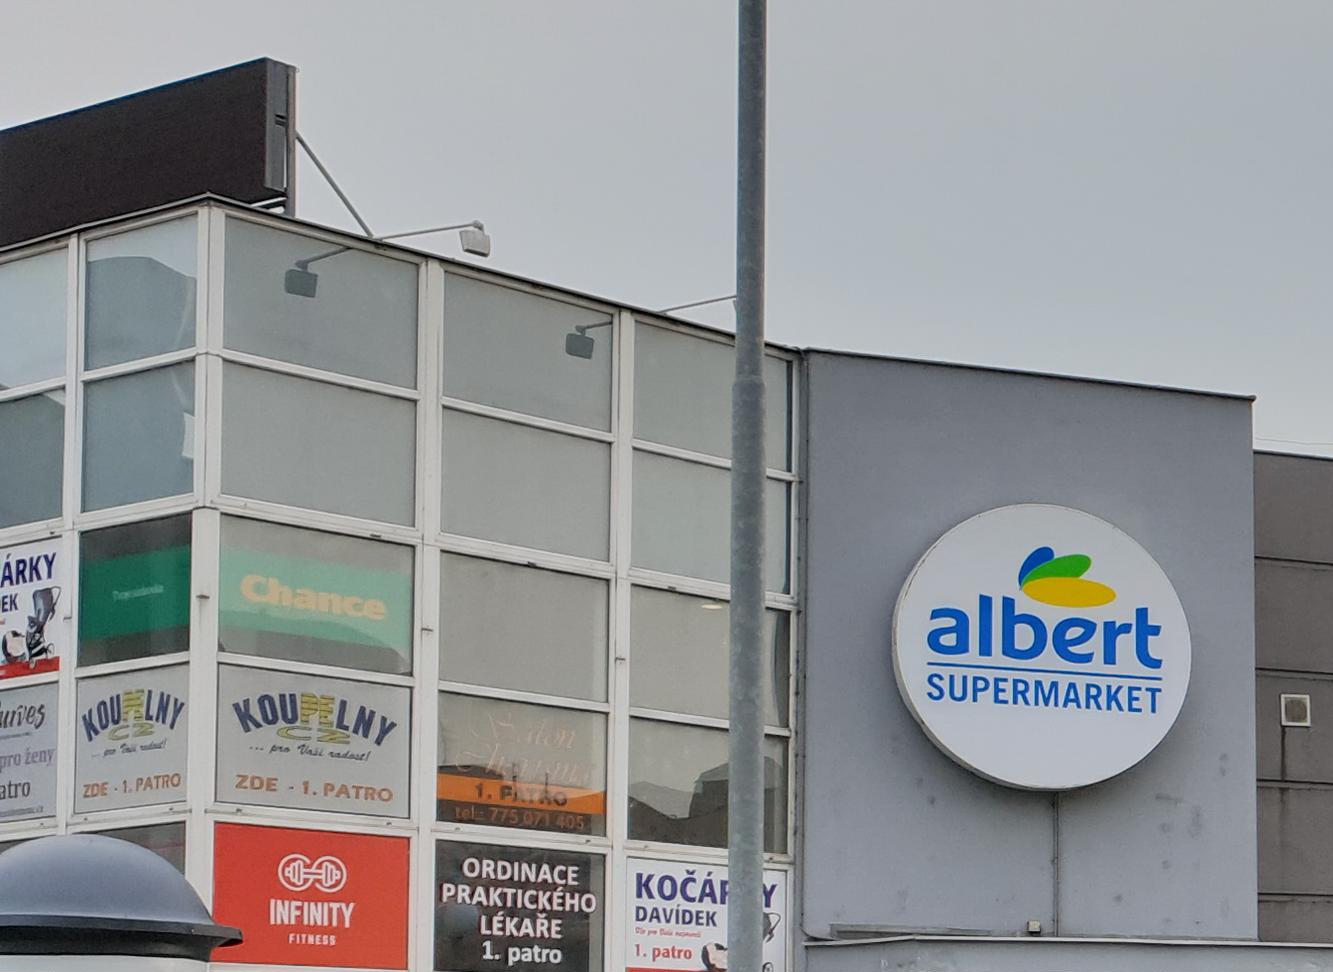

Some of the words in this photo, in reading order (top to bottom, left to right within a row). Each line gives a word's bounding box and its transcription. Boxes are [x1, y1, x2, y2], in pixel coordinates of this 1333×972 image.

[0, 552, 57, 588] ÁRKY
[0, 592, 18, 612] EK
[239, 574, 388, 621] Chance
[927, 593, 1163, 669] albert
[926, 673, 1162, 714] SUPERMARKET
[232, 693, 398, 747] KOUPELNY
[268, 744, 291, 754] pro
[0, 781, 31, 800] atro
[83, 782, 109, 798] ZDE
[136, 773, 181, 792] PATRO
[235, 774, 278, 793] ZDE
[302, 780, 317, 797] 1.
[323, 782, 393, 802] PATRO
[462, 857, 580, 886] ORDINACE
[441, 883, 597, 914] PRAKTICKÉHO
[635, 869, 778, 908] KOČÁY
[269, 899, 356, 928] INFINITY
[480, 911, 563, 939] LÉKAŘE
[635, 904, 718, 927] DAVÍDEK
[288, 933, 337, 946] FITNESS
[481, 940, 501, 961] 1.
[507, 944, 563, 966] patro
[634, 944, 647, 957] 1.
[652, 945, 693, 962] patro
